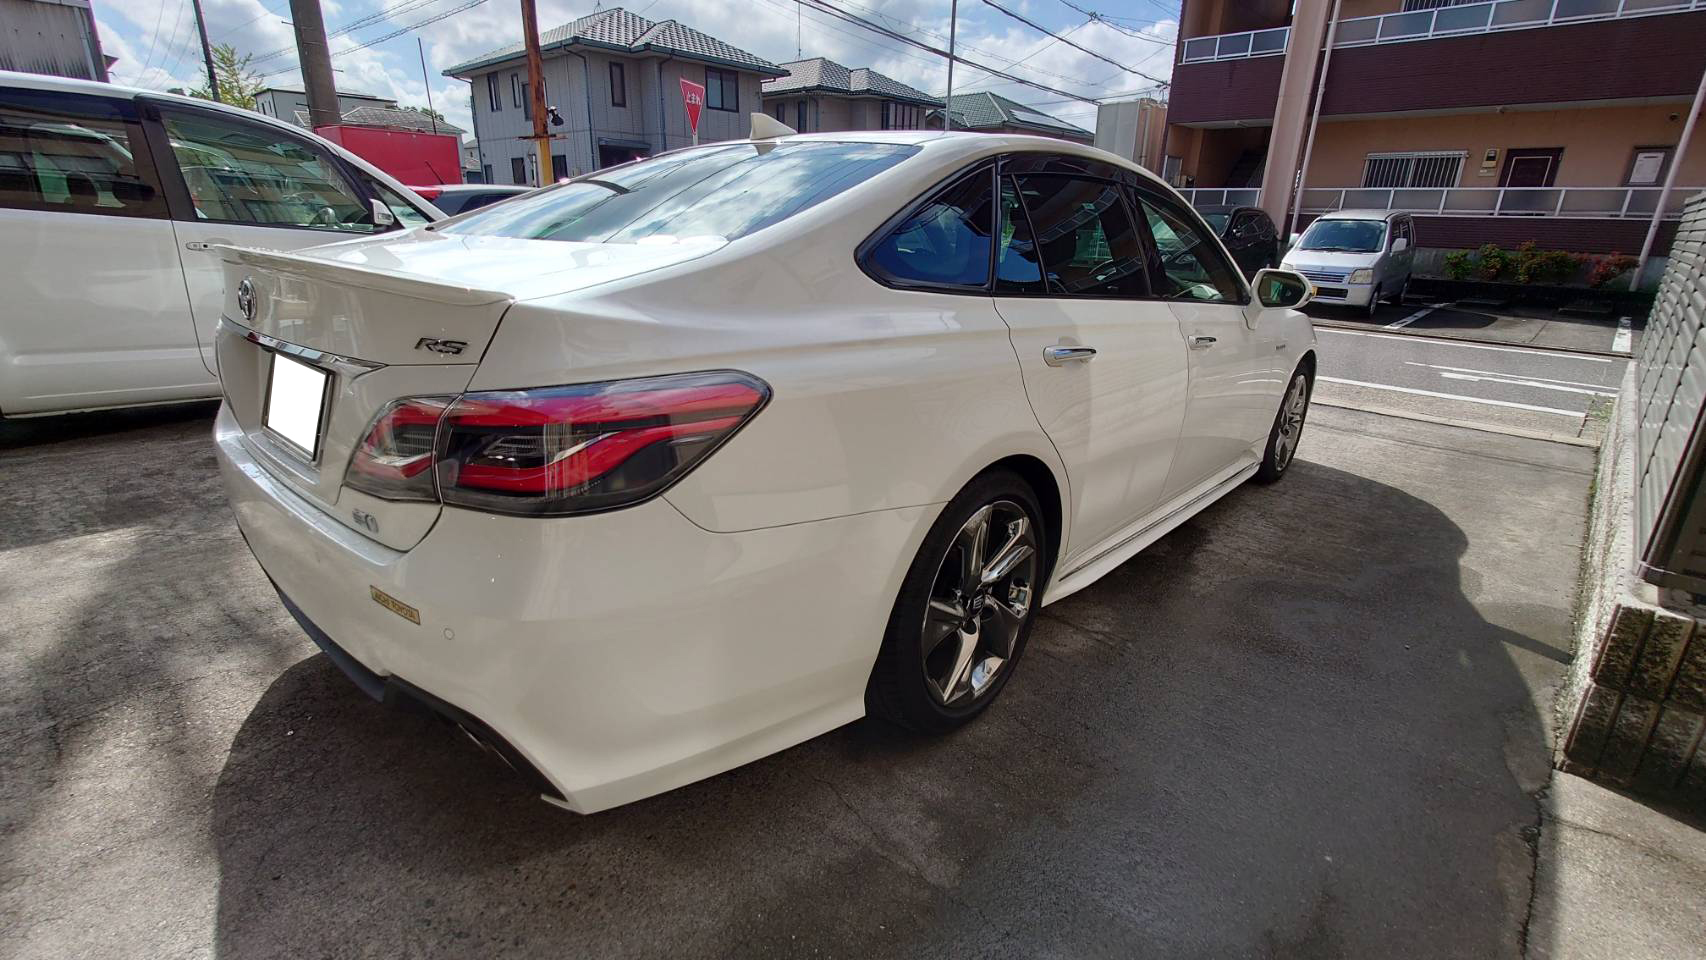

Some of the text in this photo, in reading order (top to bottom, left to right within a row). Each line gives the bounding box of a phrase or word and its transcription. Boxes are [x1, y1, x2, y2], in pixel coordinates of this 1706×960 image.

[686, 91, 701, 105] 止まれ
[414, 337, 468, 354] RS
